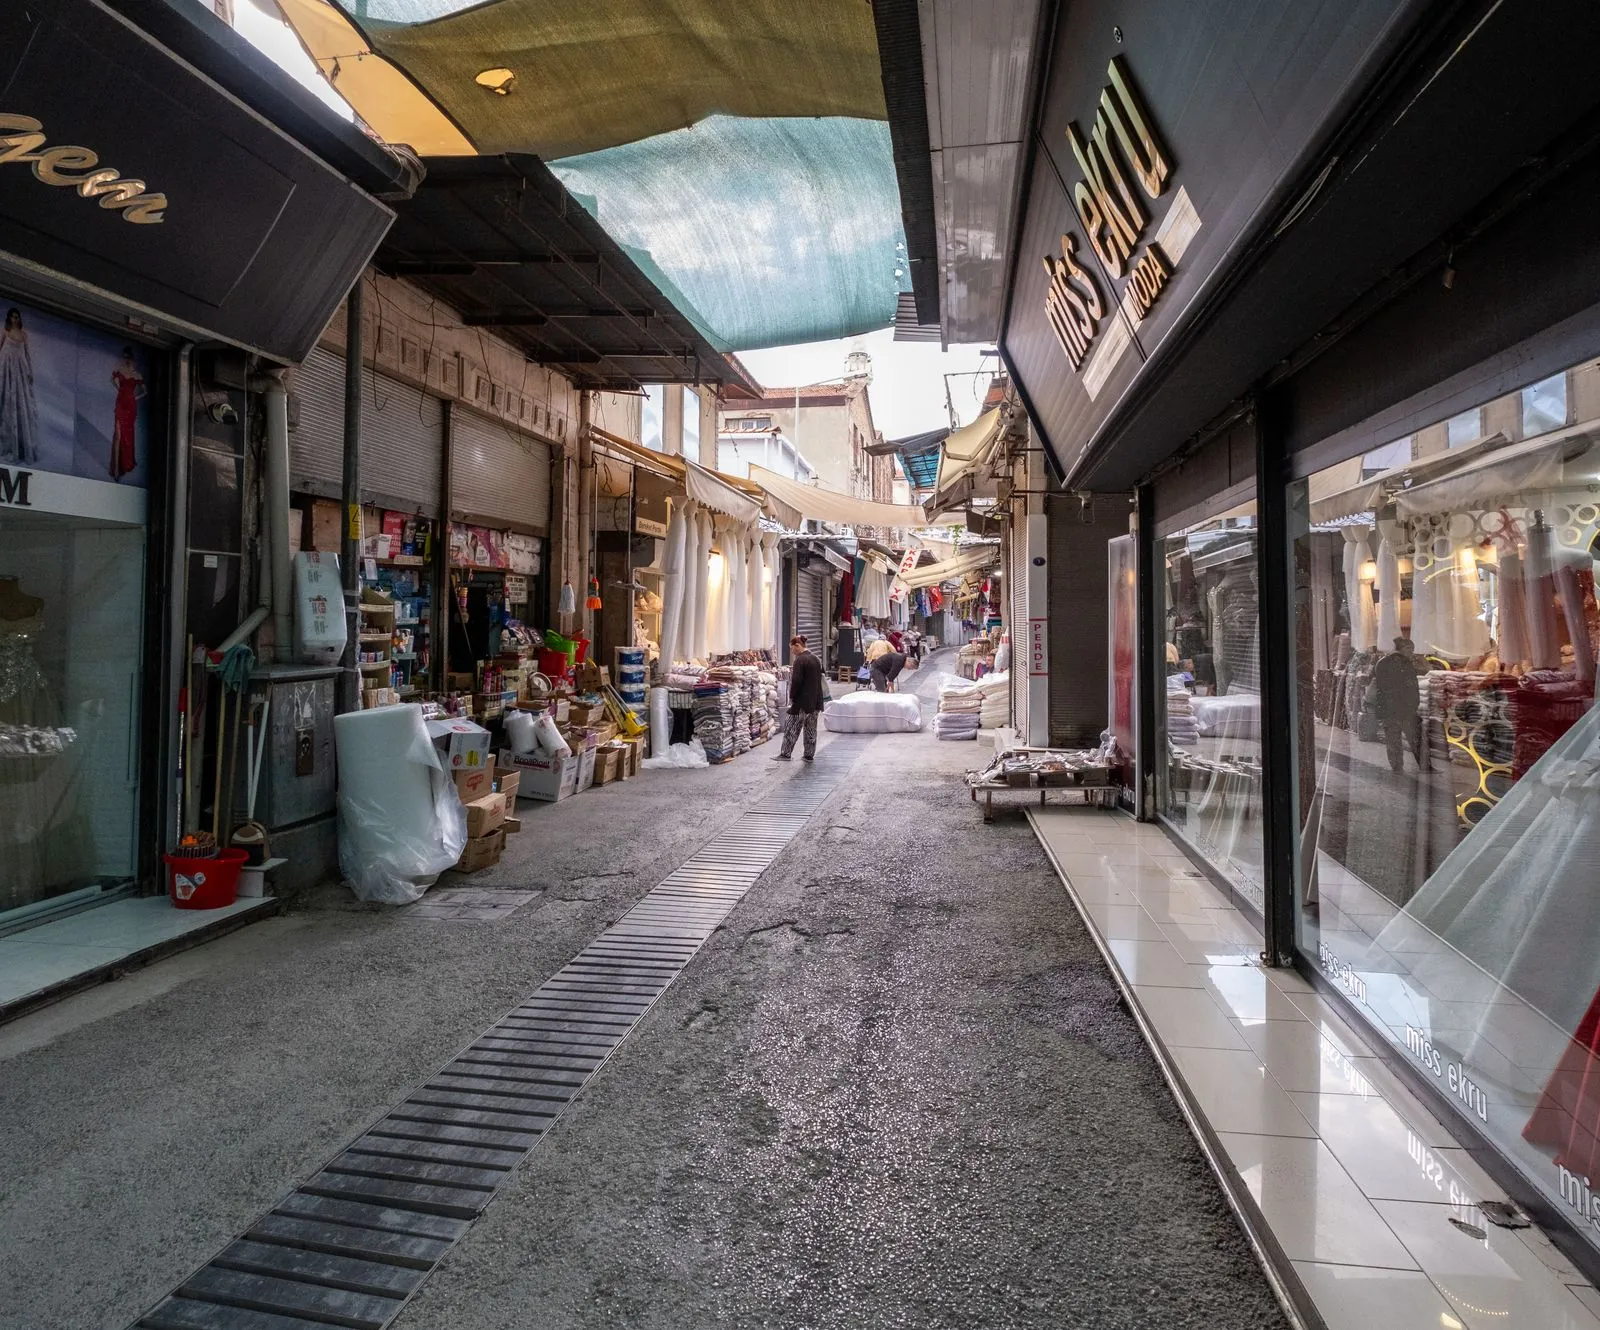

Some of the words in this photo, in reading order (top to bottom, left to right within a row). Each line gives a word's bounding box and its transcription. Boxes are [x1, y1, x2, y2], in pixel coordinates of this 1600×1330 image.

[1043, 232, 1106, 374] miss
[1124, 242, 1169, 321] MODA
[1034, 623, 1044, 671] PERDE
[1405, 1022, 1442, 1078] miss
[1448, 1060, 1488, 1124] ekru
